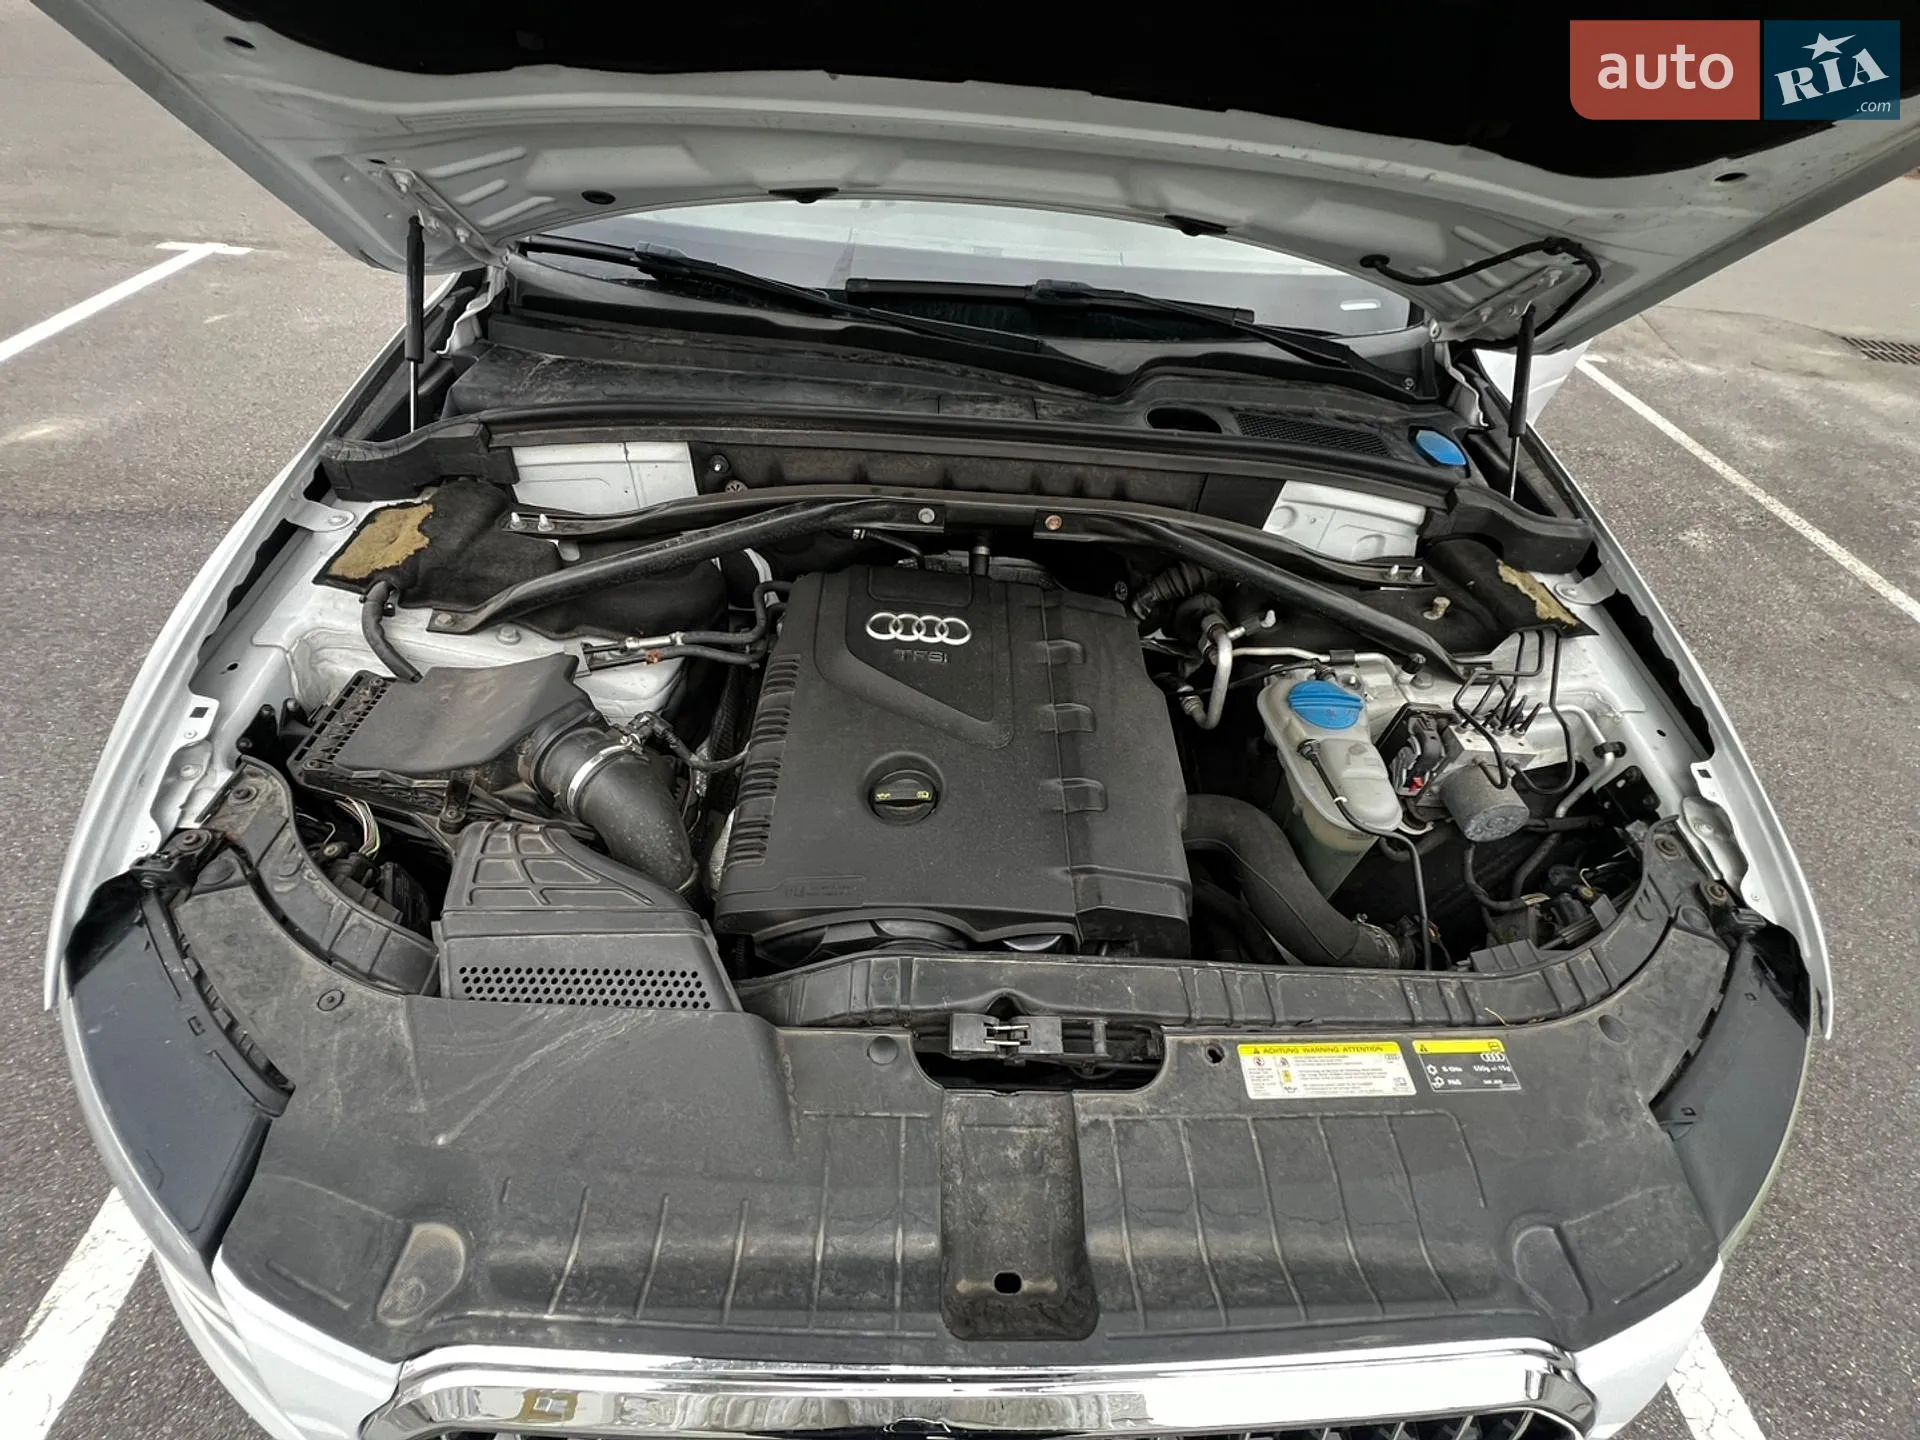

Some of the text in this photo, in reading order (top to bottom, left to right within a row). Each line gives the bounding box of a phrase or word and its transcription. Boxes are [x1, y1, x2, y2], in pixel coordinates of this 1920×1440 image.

[1263, 1045, 1384, 1055] ACHTUNG WARNING ATTENTION
